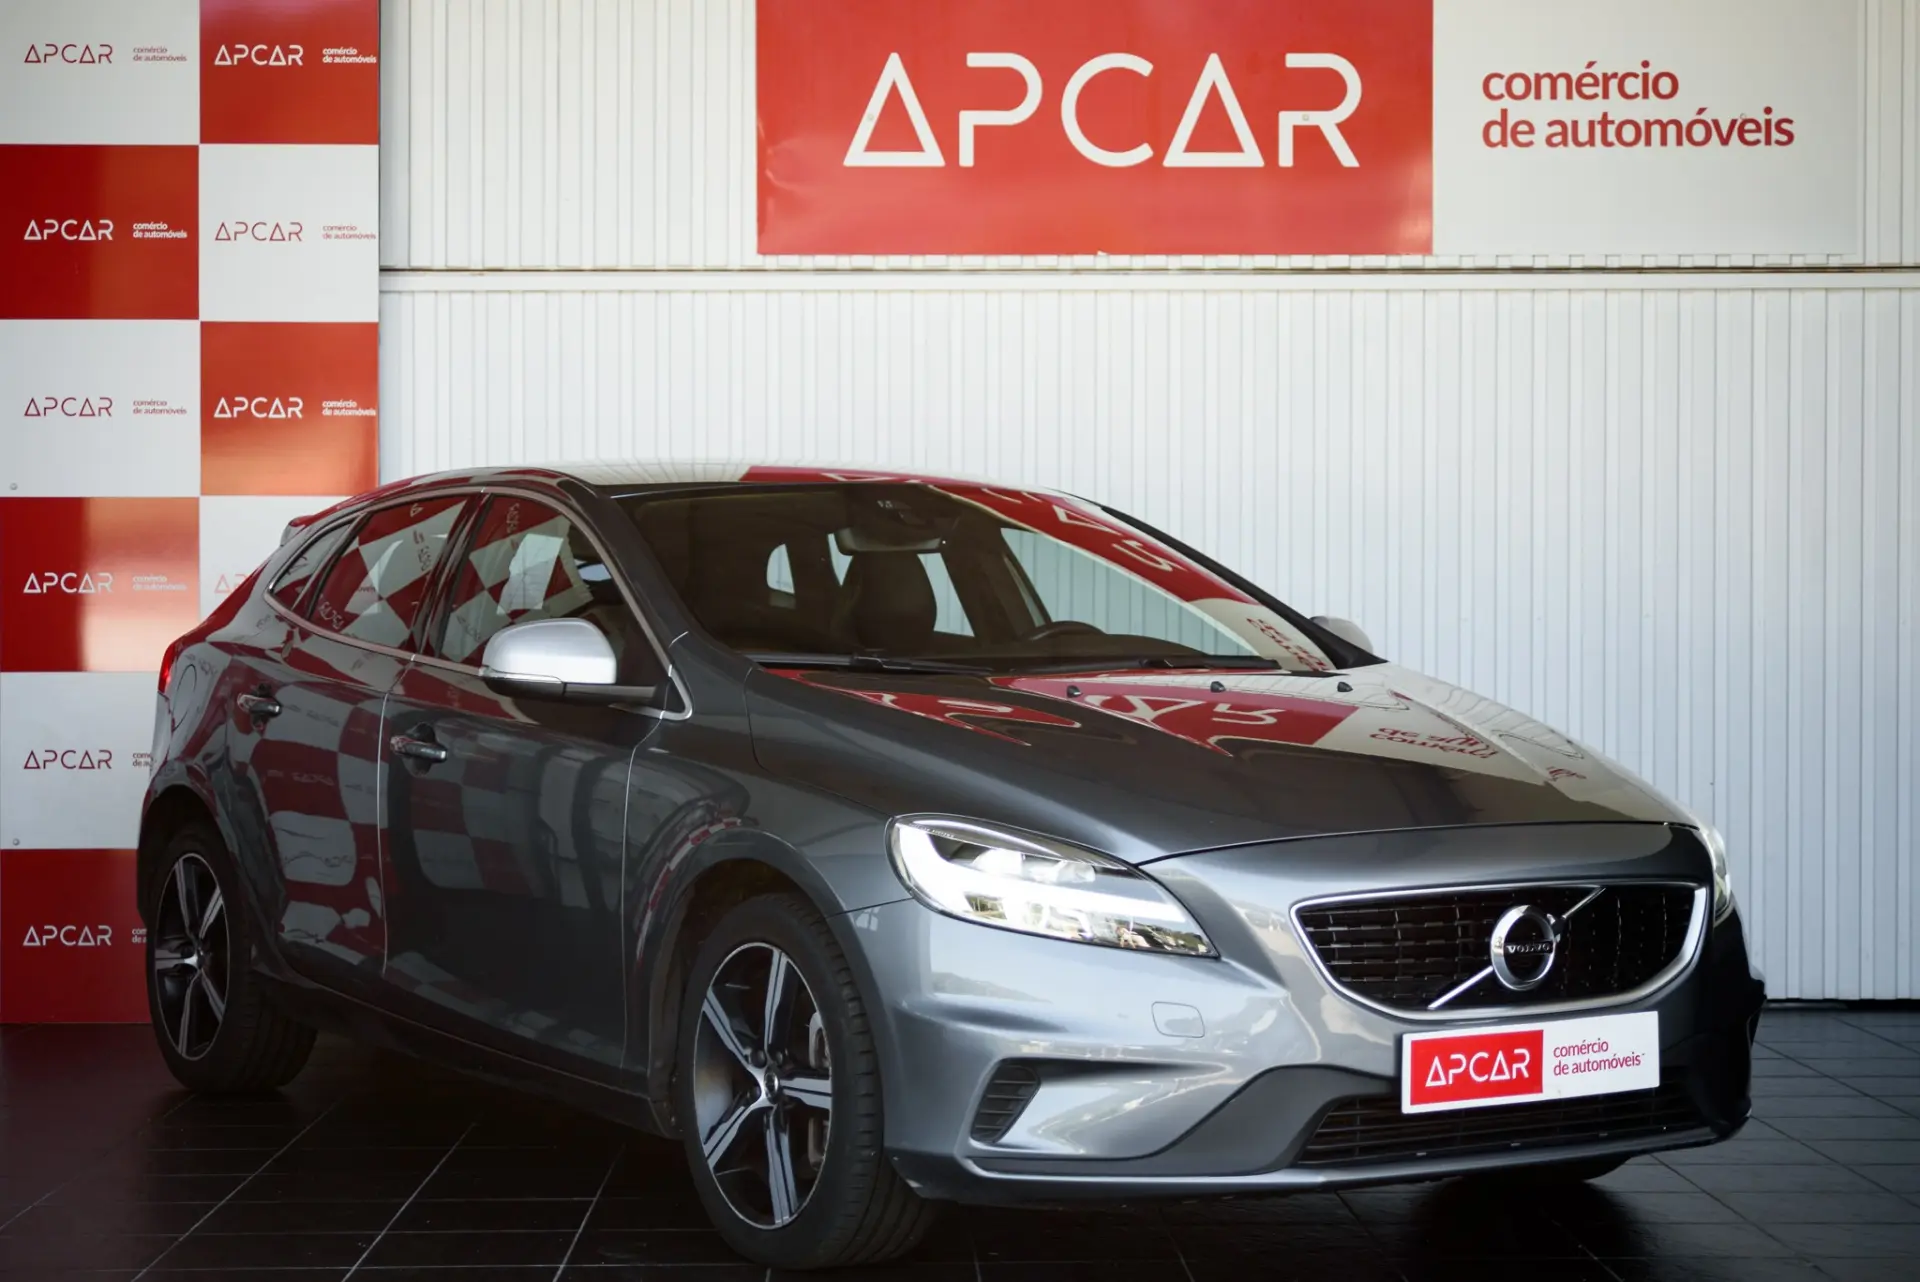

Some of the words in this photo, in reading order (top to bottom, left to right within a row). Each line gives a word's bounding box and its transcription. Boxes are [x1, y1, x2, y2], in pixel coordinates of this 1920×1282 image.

[24, 43, 113, 64] APCAR
[214, 44, 304, 66] APCAR
[1482, 60, 1680, 100] comércio
[843, 53, 1362, 168] APCAR
[1482, 108, 1536, 148] de
[1544, 106, 1795, 148] automóveis
[24, 219, 114, 241] APCAR
[214, 221, 304, 242] APCAR
[24, 396, 113, 417] APCAR
[213, 396, 304, 418] APCAR
[23, 572, 114, 594] APCAR
[24, 749, 113, 770] APCAR
[23, 924, 113, 947] APCAR
[1553, 1037, 1609, 1059] comércio
[1425, 1048, 1531, 1088] APCAR
[1553, 1060, 1570, 1077] de
[1571, 1051, 1641, 1075] automóveis
